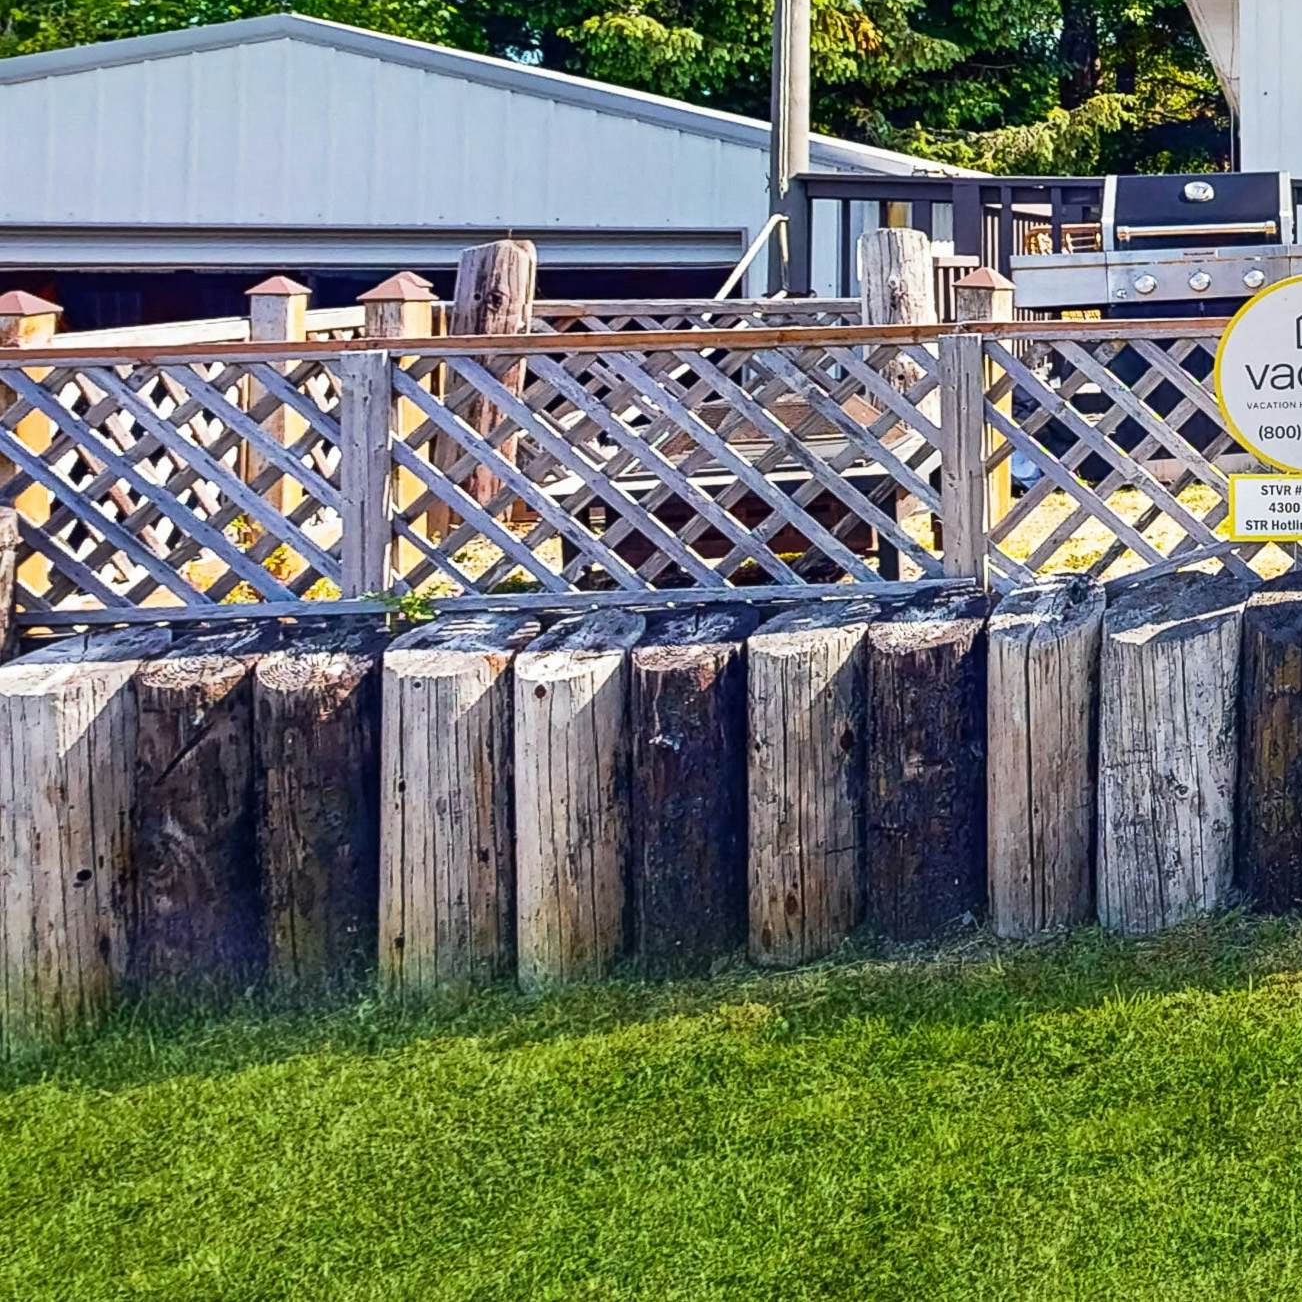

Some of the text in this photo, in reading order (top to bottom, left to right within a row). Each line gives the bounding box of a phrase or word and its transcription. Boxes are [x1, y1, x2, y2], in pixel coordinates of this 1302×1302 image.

[1247, 401, 1297, 410] VACATION
[1258, 424, 1302, 441] (800)
[1260, 484, 1291, 496] STVR
[1295, 485, 1302, 496] #
[1268, 502, 1300, 513] 4300
[1245, 519, 1268, 531] STR
